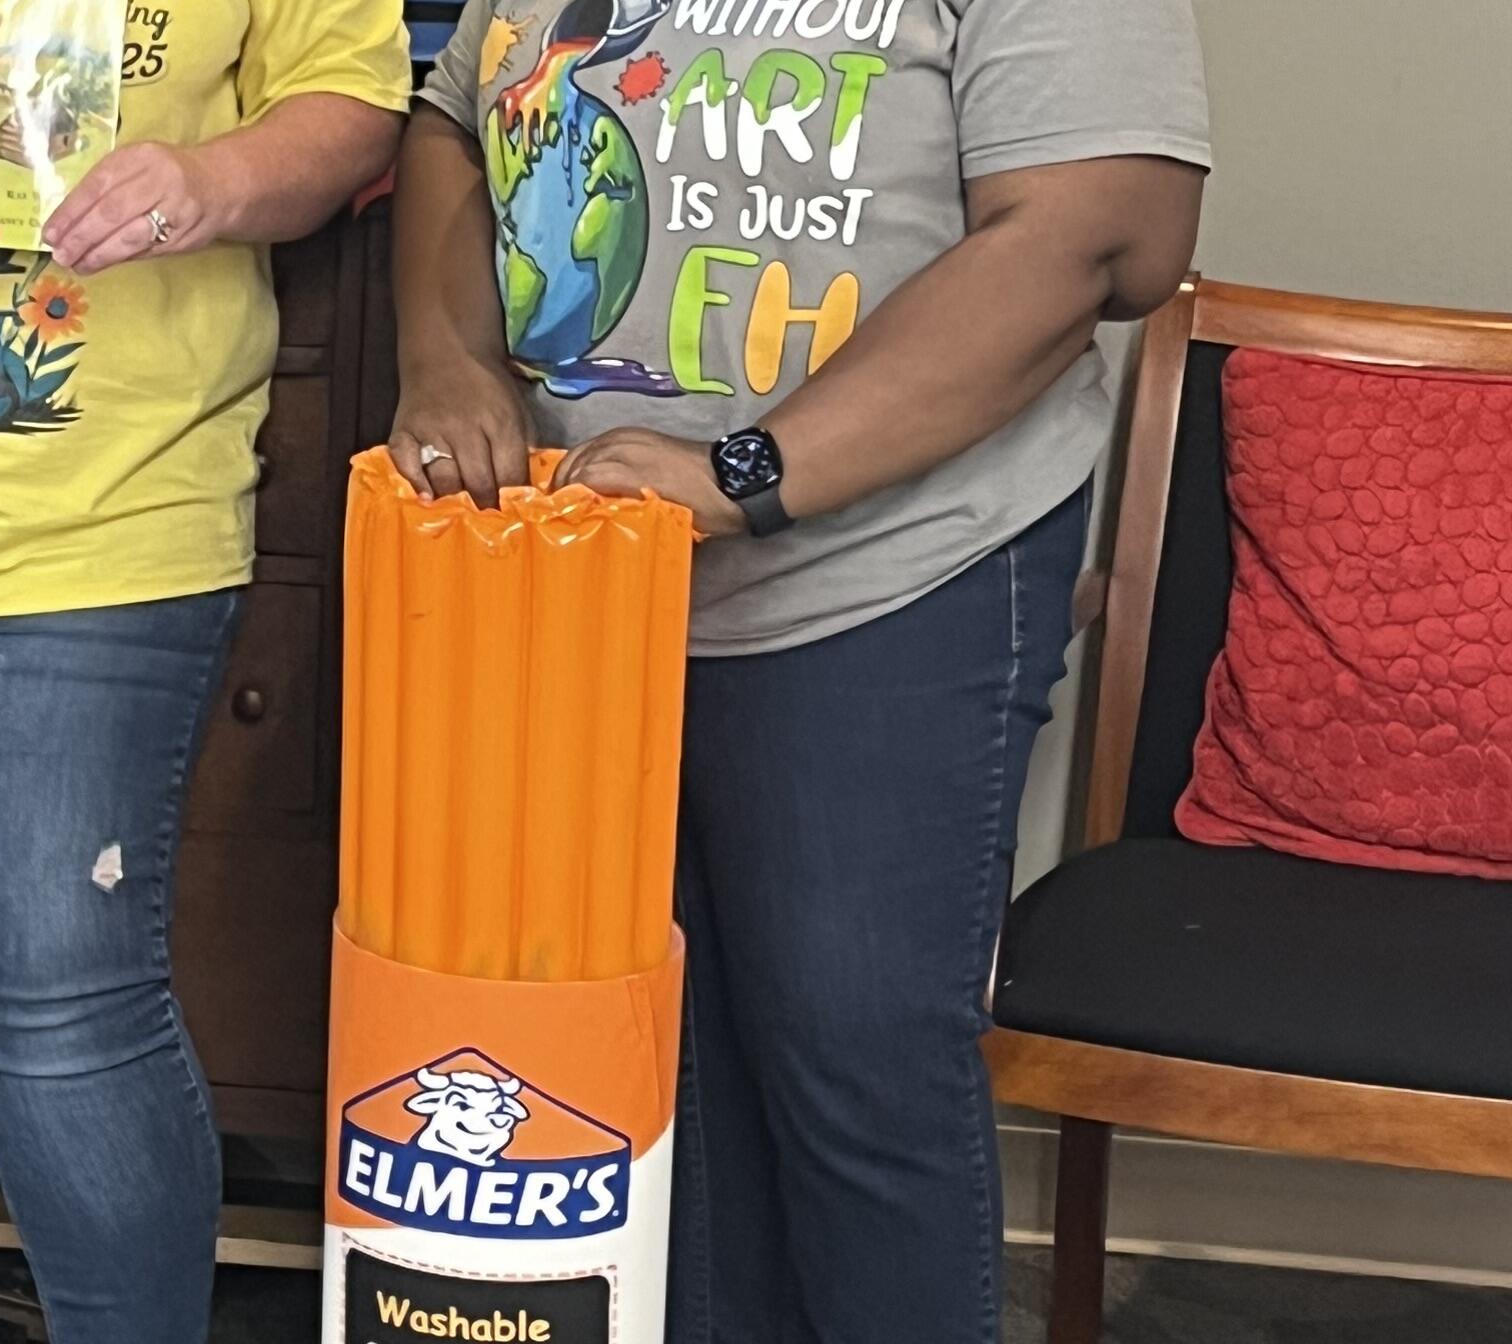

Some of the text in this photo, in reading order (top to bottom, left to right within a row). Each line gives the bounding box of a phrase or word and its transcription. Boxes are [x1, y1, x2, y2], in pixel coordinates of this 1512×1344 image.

[121, 43, 169, 80] 25
[655, 48, 888, 181] ART
[666, 175, 874, 246] IS JUST
[667, 244, 861, 396] EH
[344, 1138, 620, 1228] ELMER'S
[375, 1290, 552, 1344] Washable
